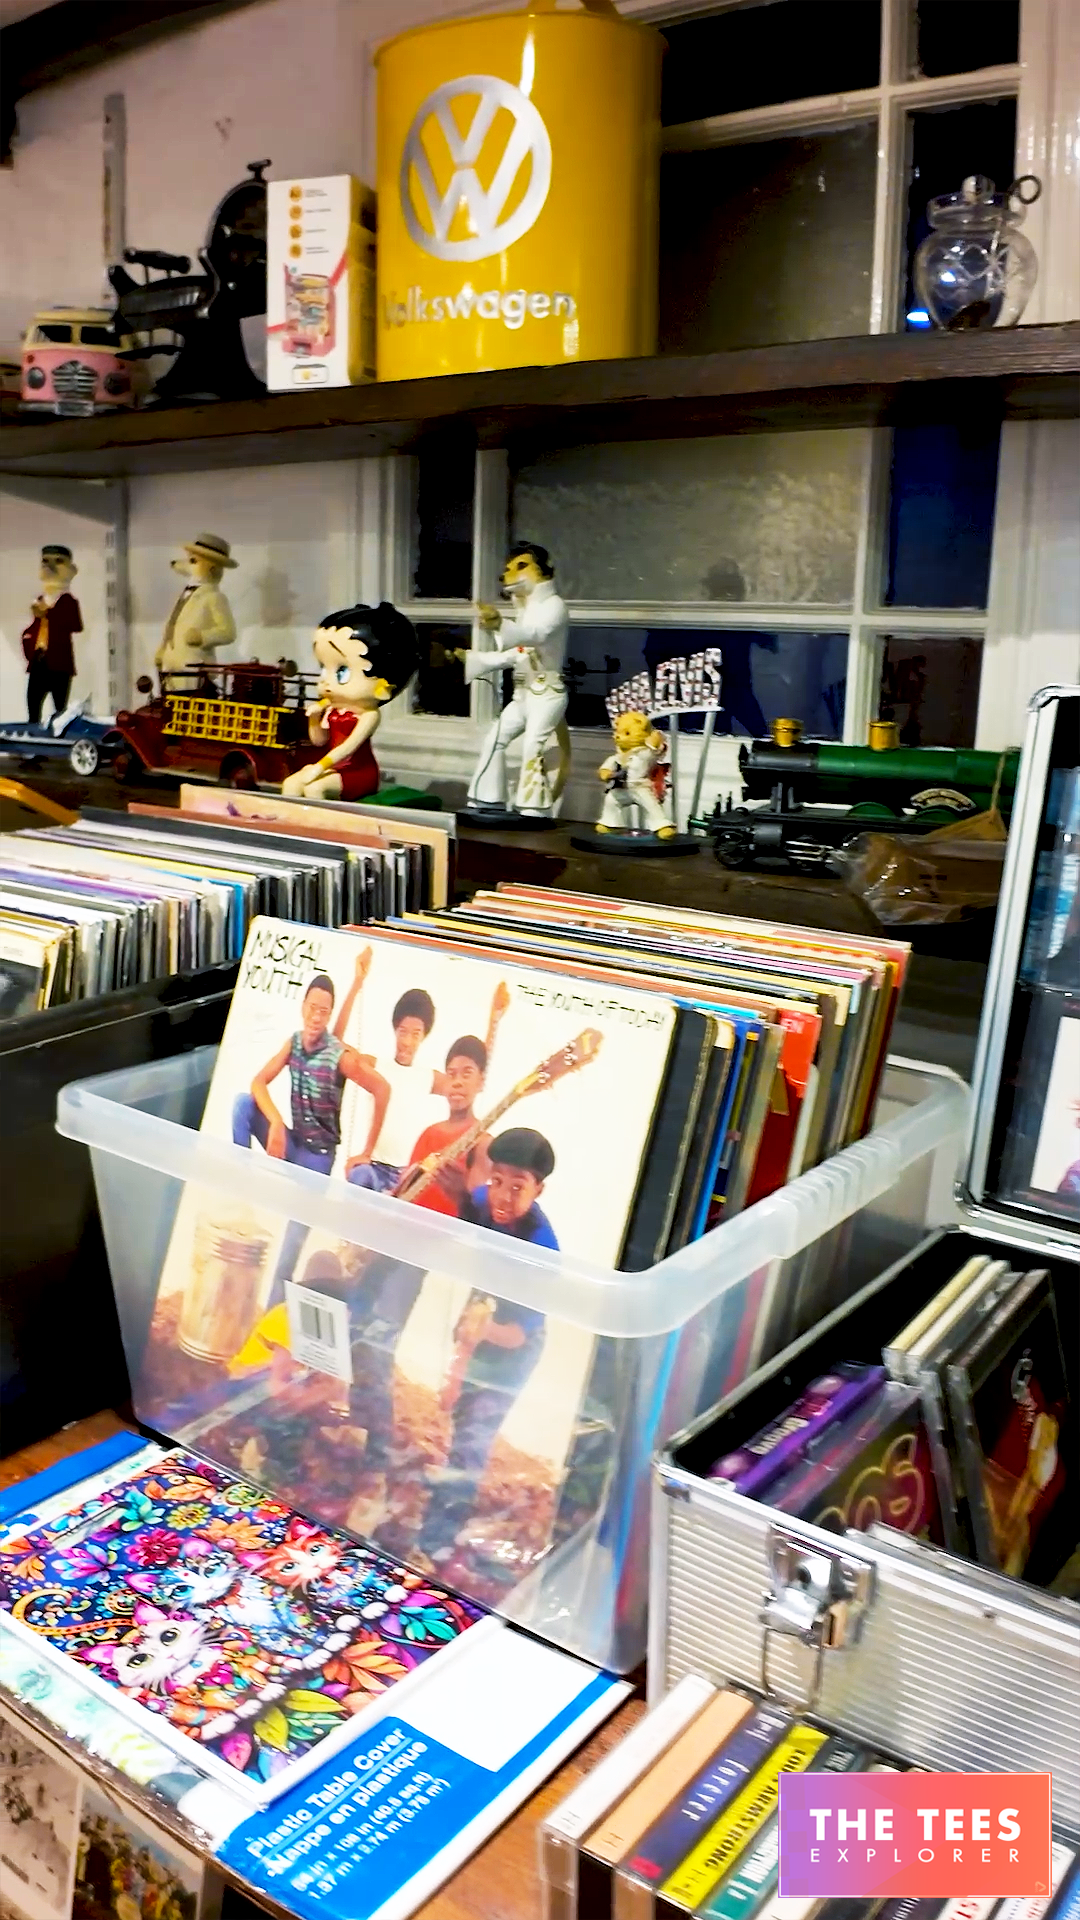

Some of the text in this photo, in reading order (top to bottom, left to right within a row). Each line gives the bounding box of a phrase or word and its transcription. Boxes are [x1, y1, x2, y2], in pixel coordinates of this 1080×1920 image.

[243, 962, 303, 999] YOUTH
[249, 930, 328, 973] MUSICAL
[517, 984, 548, 1007] THE
[552, 992, 594, 1016] YOUTH
[619, 1006, 669, 1032] TODAY
[246, 1728, 406, 1858] Plastic Table Cover
[264, 1741, 428, 1873] Nappe en plastique
[682, 1758, 750, 1821] forever
[335, 1860, 353, 1877] m
[384, 1818, 402, 1834] m
[356, 1821, 375, 1837] in
[704, 1785, 777, 1869] ARMSTRONG
